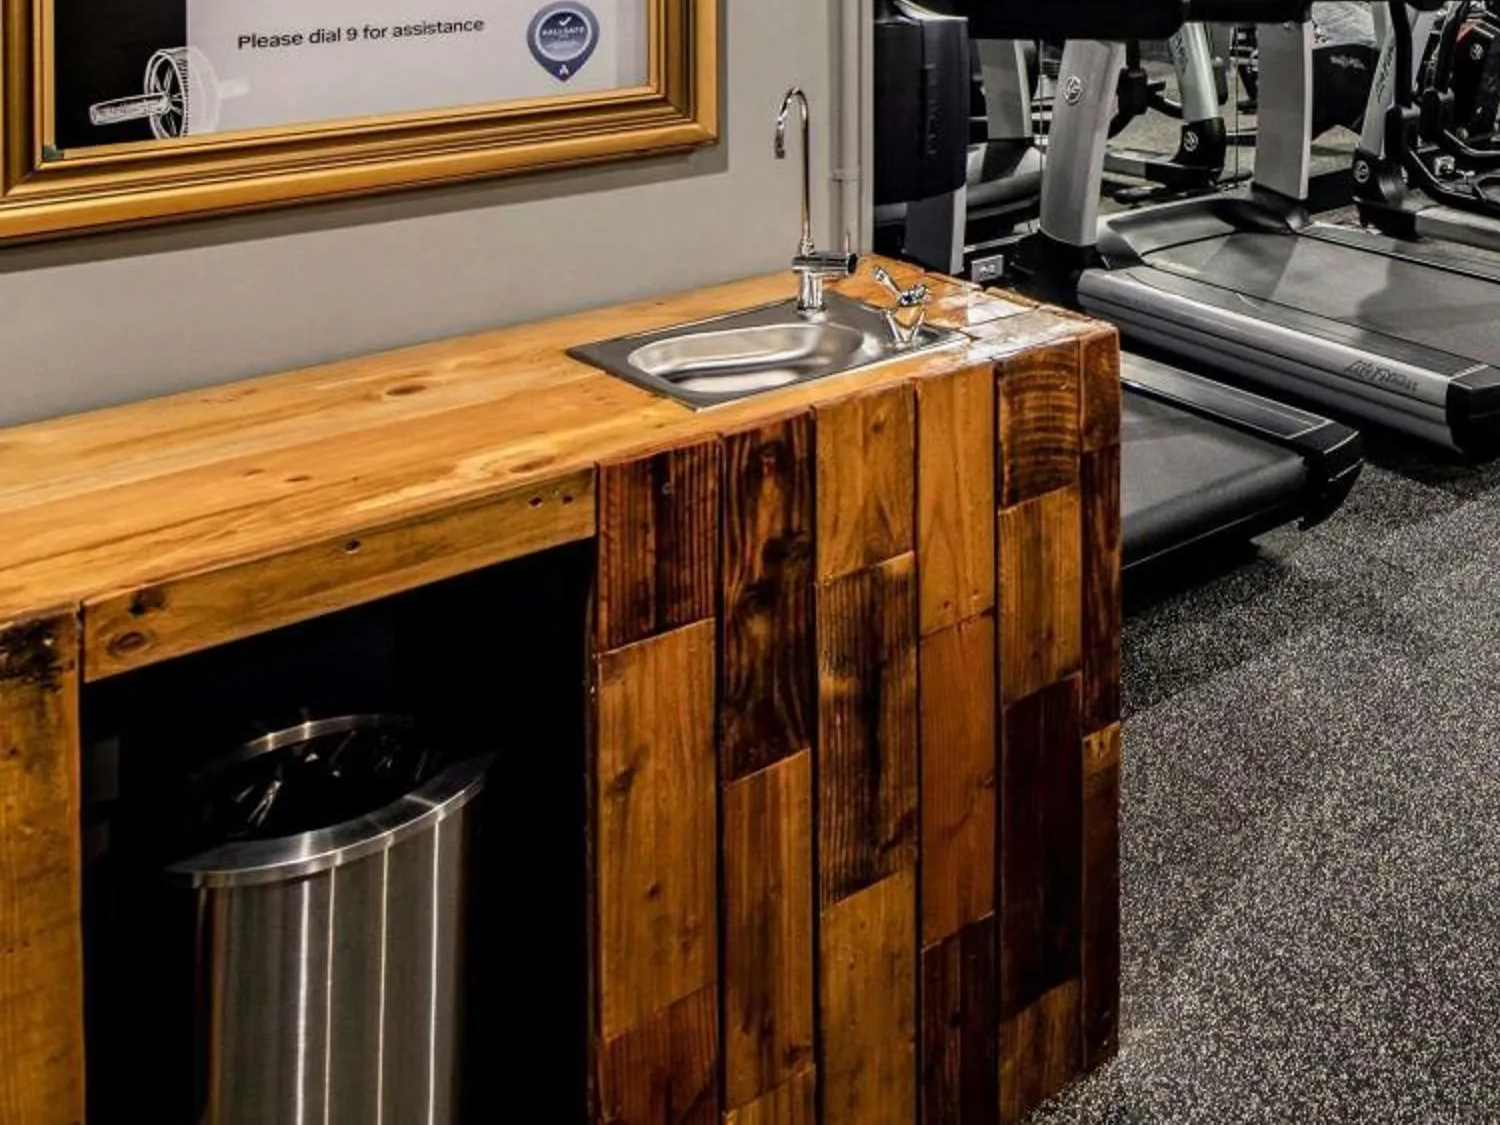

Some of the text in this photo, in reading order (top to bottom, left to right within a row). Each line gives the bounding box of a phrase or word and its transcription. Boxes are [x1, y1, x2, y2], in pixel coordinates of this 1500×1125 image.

[238, 21, 483, 49] Please dial 9 for assistance
